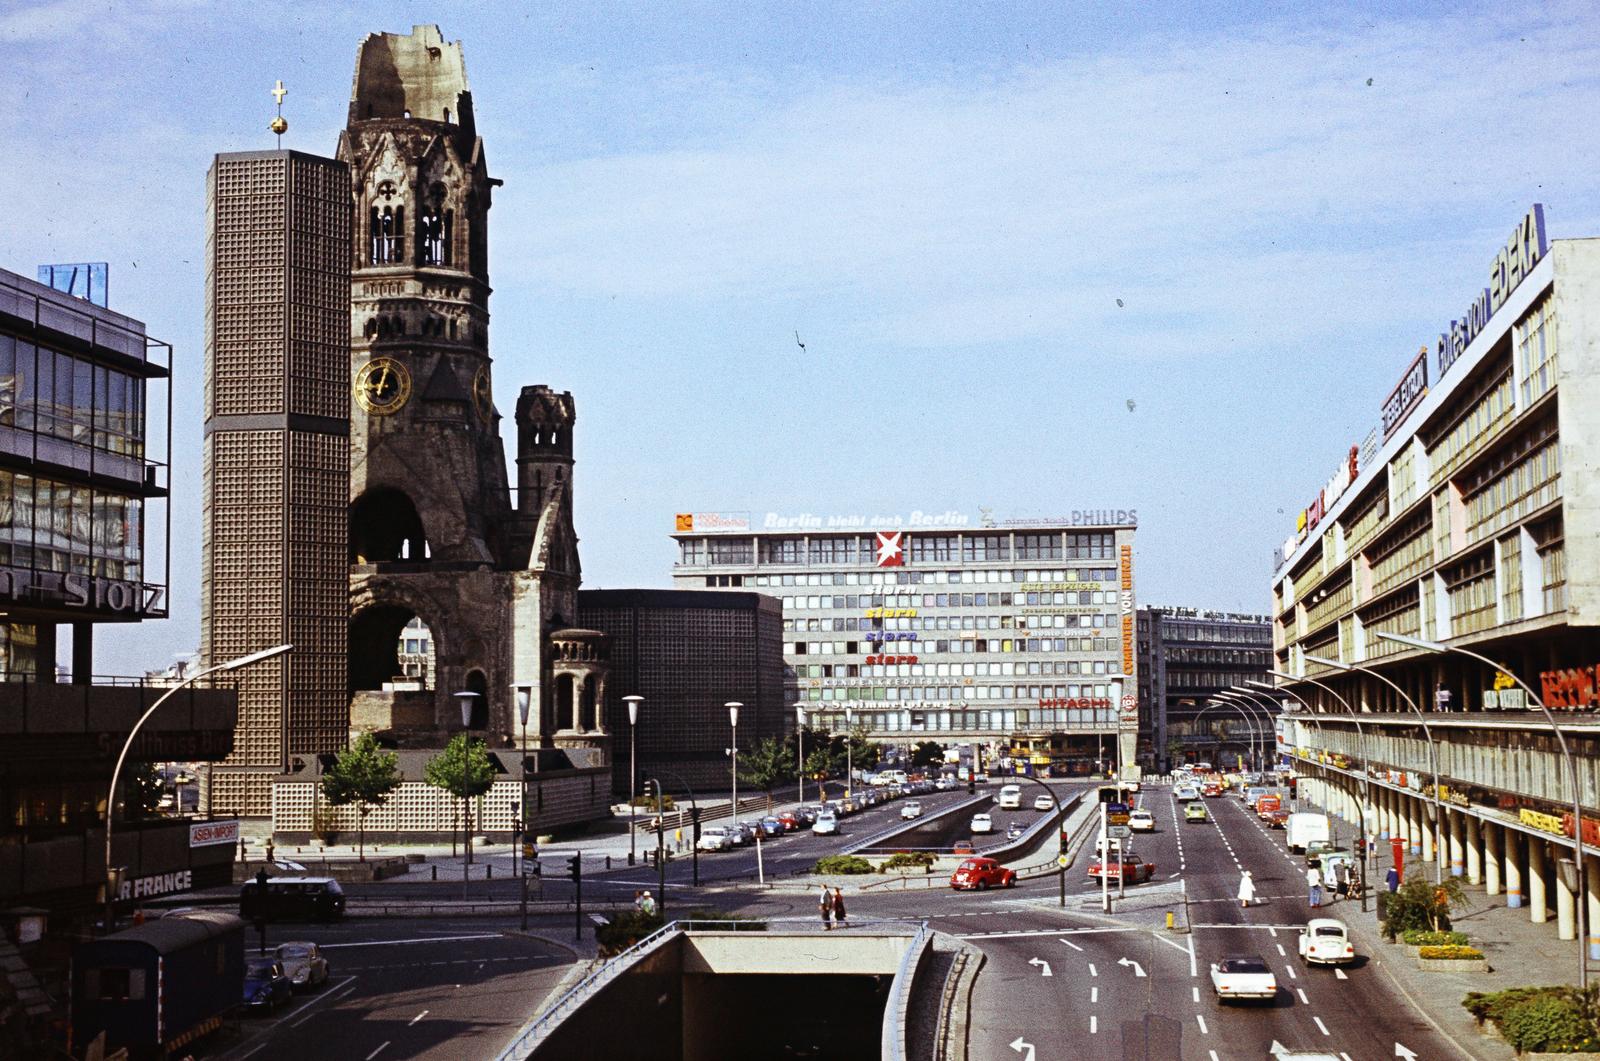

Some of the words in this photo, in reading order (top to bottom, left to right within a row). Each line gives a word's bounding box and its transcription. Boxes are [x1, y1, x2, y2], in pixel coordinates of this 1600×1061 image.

[1438, 317, 1469, 374] Gutes
[1467, 288, 1491, 342] von
[1490, 203, 1547, 315] EDEKA
[764, 512, 822, 528] Berlin
[827, 515, 865, 527] bleibt
[870, 514, 903, 526] doch
[909, 509, 969, 526] Berlin
[1071, 508, 1138, 526] PHILIPS
[1120, 544, 1132, 590] KIENZLE
[864, 584, 917, 595] stern
[1049, 582, 1101, 591] LEIPZIGER
[864, 606, 917, 618] stern
[1121, 591, 1132, 616] VON
[865, 629, 918, 642] stern
[1122, 616, 1133, 675] COMPUTER
[865, 652, 918, 666] stern
[1039, 698, 1111, 710] HITACHI
[134, 869, 192, 899] FRANCE
